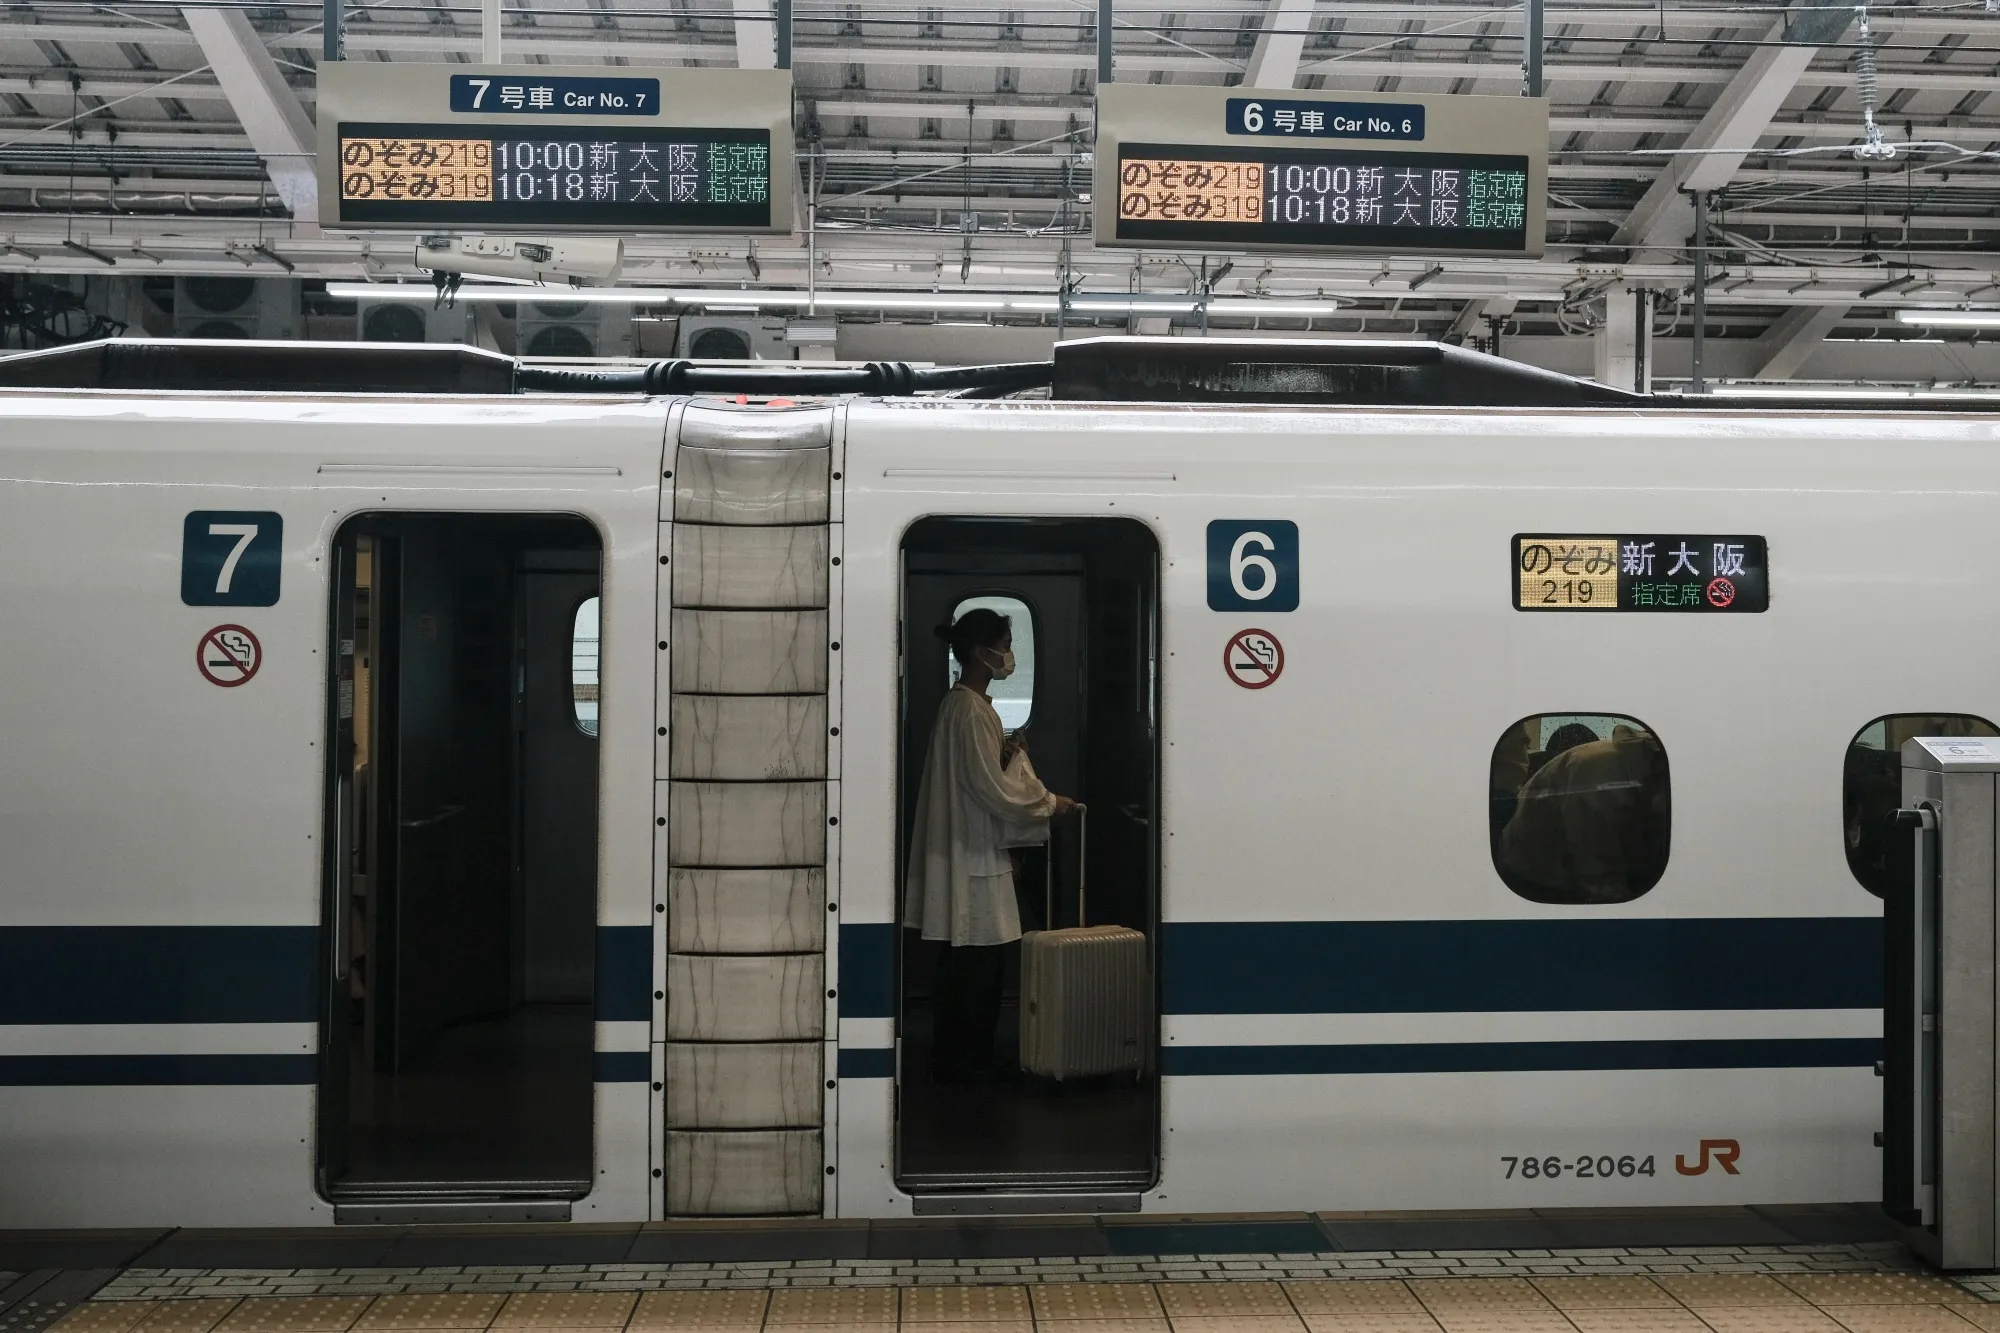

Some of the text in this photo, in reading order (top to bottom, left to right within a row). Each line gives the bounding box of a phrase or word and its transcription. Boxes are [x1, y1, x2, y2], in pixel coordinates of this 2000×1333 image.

[563, 91, 595, 107] Car
[599, 92, 629, 108] No.
[635, 93, 646, 108] 7
[1333, 116, 1363, 132] Car
[1367, 117, 1395, 133] No.
[1401, 119, 1412, 133] 6
[496, 142, 583, 170] 10:00
[706, 142, 768, 172] 指定席
[497, 172, 584, 200] 10:18
[707, 172, 768, 202] 指定席
[1268, 165, 1350, 194] 10:00
[1467, 169, 1525, 199] 指定席
[1267, 194, 1349, 223] 10:18
[1466, 199, 1525, 228] 指定席
[208, 524, 258, 593] 7
[1229, 531, 1277, 600] 6
[1521, 541, 1746, 577] のぞみ 新大阪
[1541, 579, 1702, 606] 219 指定席
[1500, 1138, 1740, 1180] 786-2064 JR
